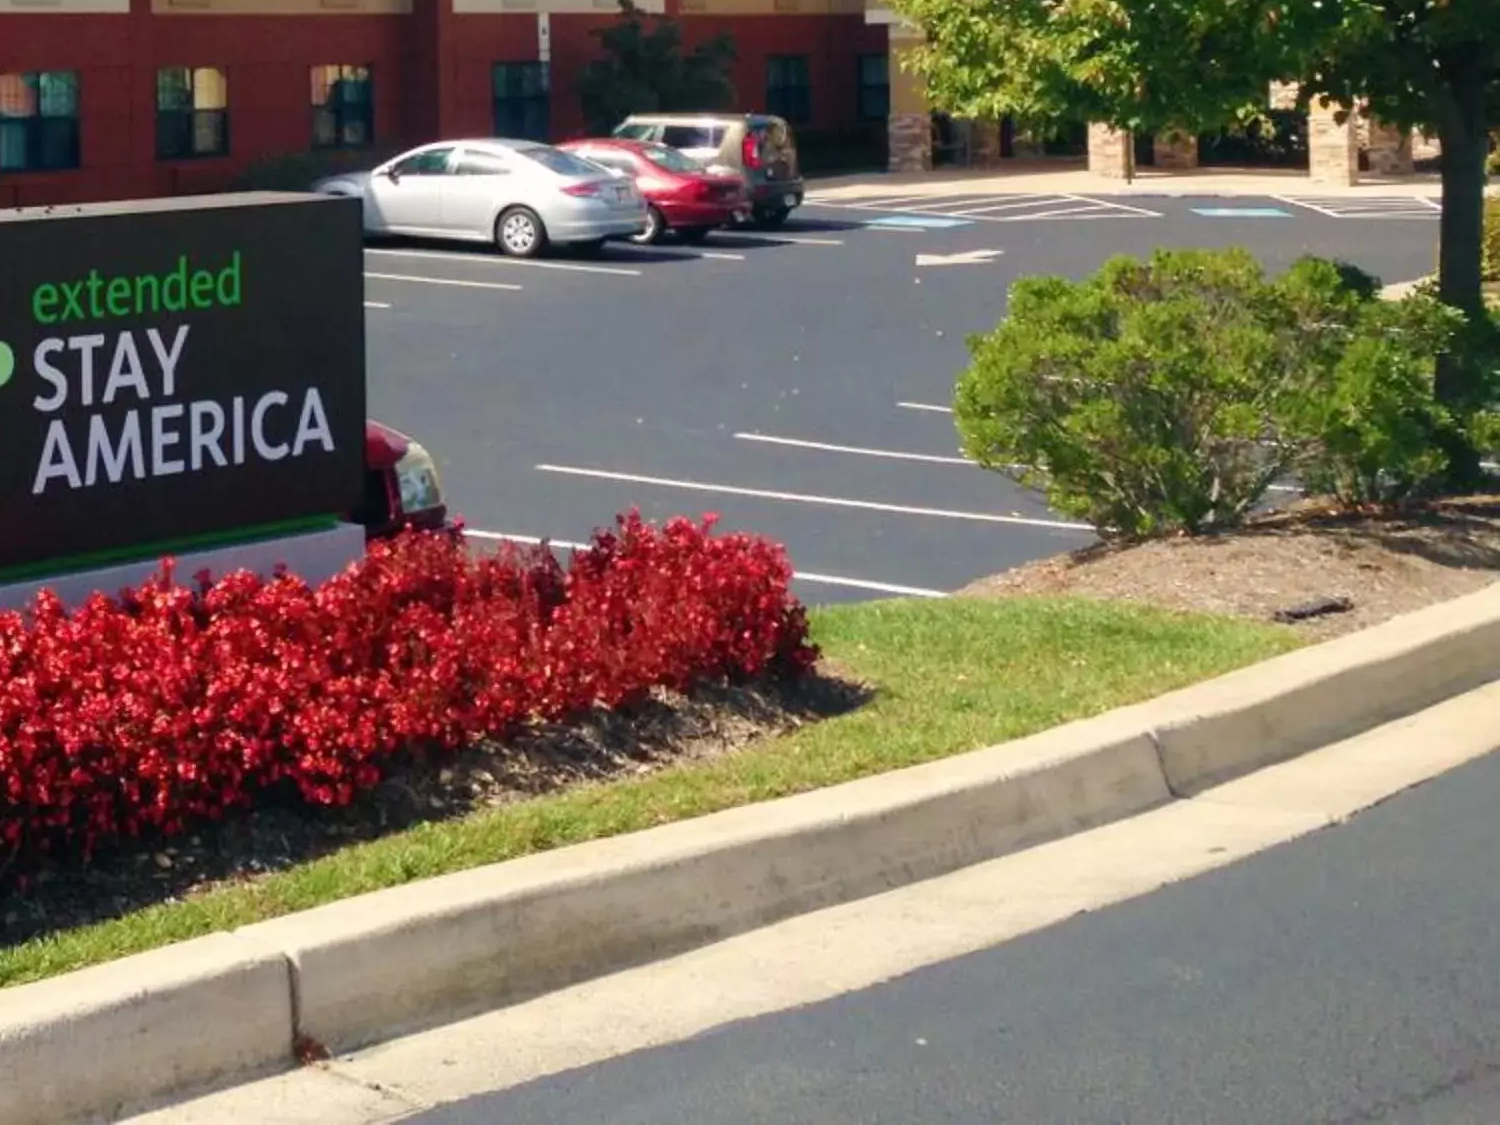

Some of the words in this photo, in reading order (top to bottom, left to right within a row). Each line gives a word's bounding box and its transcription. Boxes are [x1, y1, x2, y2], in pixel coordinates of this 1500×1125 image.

[32, 252, 241, 324] extended
[32, 325, 189, 412] STAY
[31, 388, 335, 494] AMERICA
